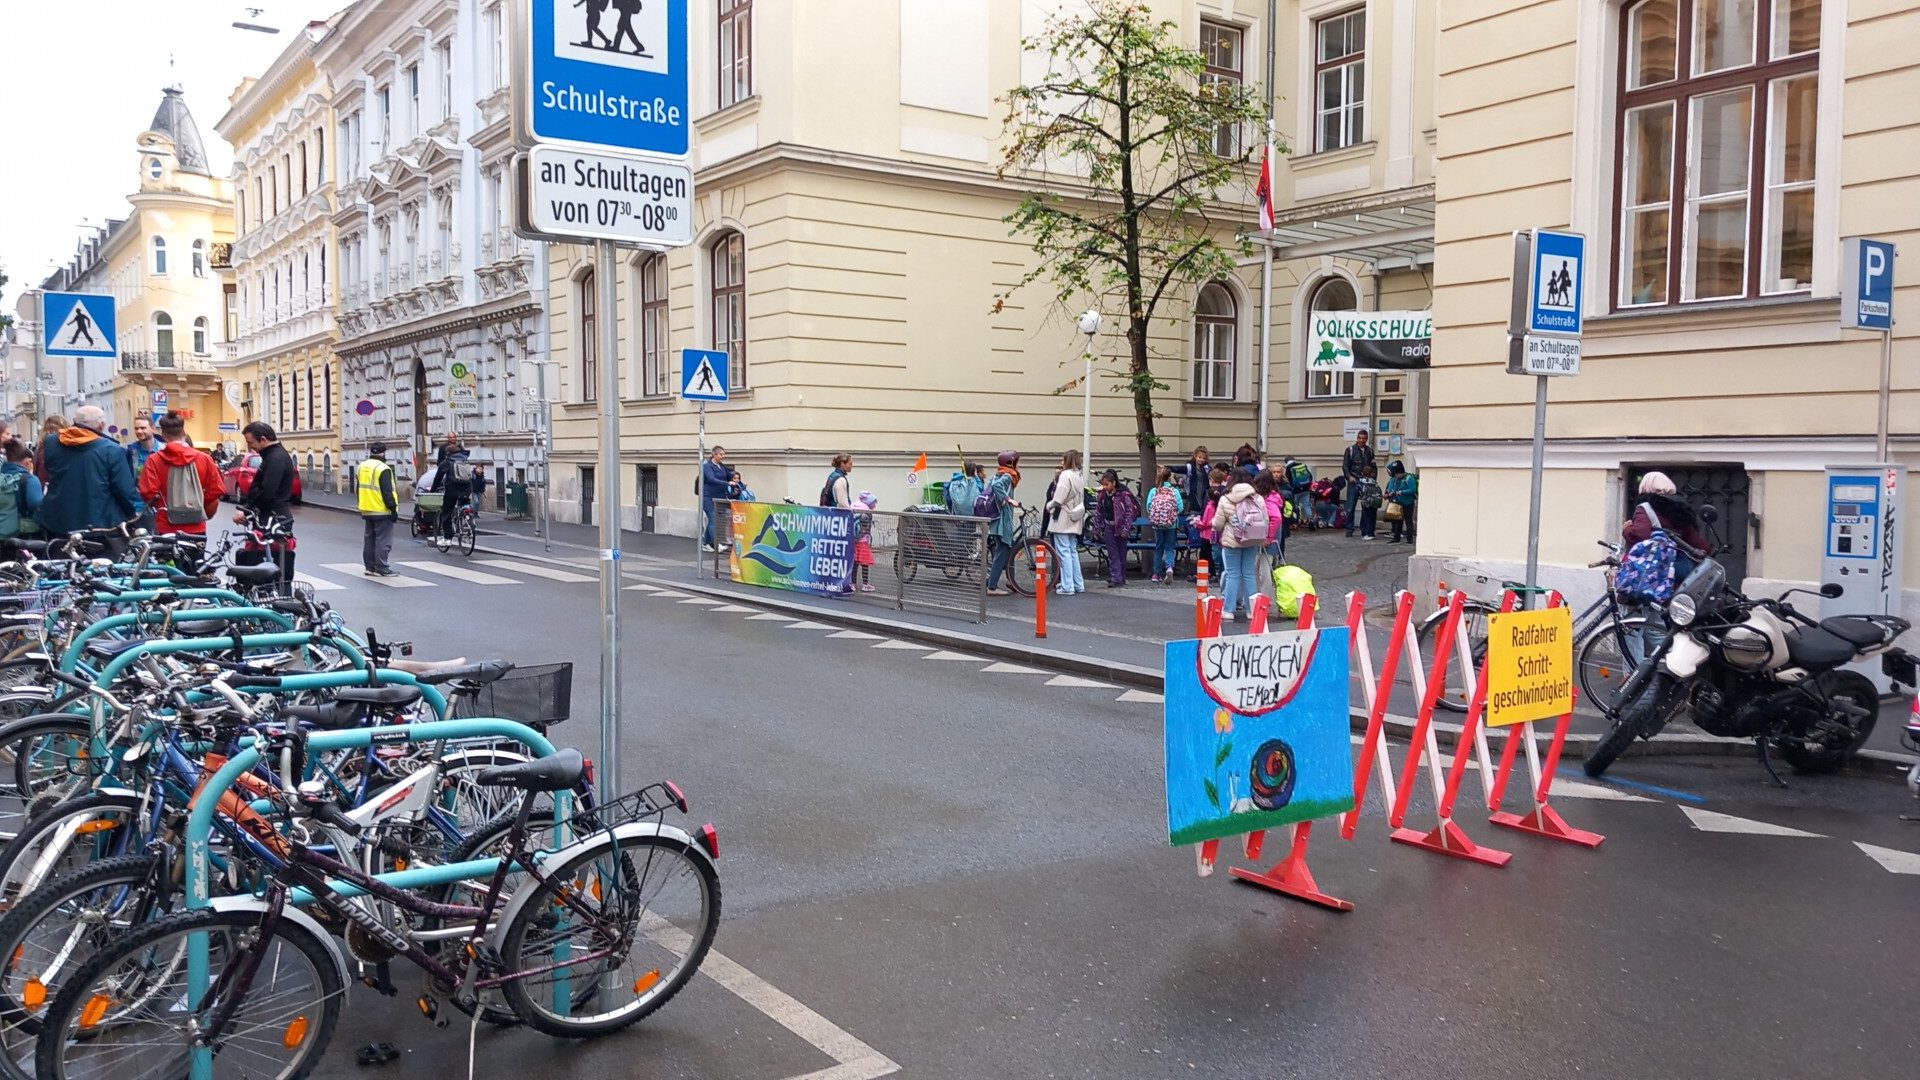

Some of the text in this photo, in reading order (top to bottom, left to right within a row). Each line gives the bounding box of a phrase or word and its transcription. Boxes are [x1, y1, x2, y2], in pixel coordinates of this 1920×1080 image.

[542, 81, 681, 127] Schulstraße
[541, 159, 686, 201] an Schultagen
[551, 200, 589, 224] von
[1865, 245, 1885, 296] P
[1316, 319, 1431, 338] VOLKSSCHULE
[1536, 313, 1576, 327] Schulstraße
[1402, 344, 1430, 357] radio
[1529, 339, 1579, 358] an Schultagen
[1532, 358, 1545, 369] von
[772, 512, 848, 537] SCHWIMMEN
[811, 538, 848, 557] RETTET
[810, 556, 847, 578] LEBEN
[1512, 624, 1558, 647] Radfahrer
[1205, 642, 1303, 681] SCHNECKEN
[1517, 654, 1552, 677] Schritt-
[1493, 677, 1569, 714] geschwindigkeit
[324, 890, 410, 951] LIMITED
